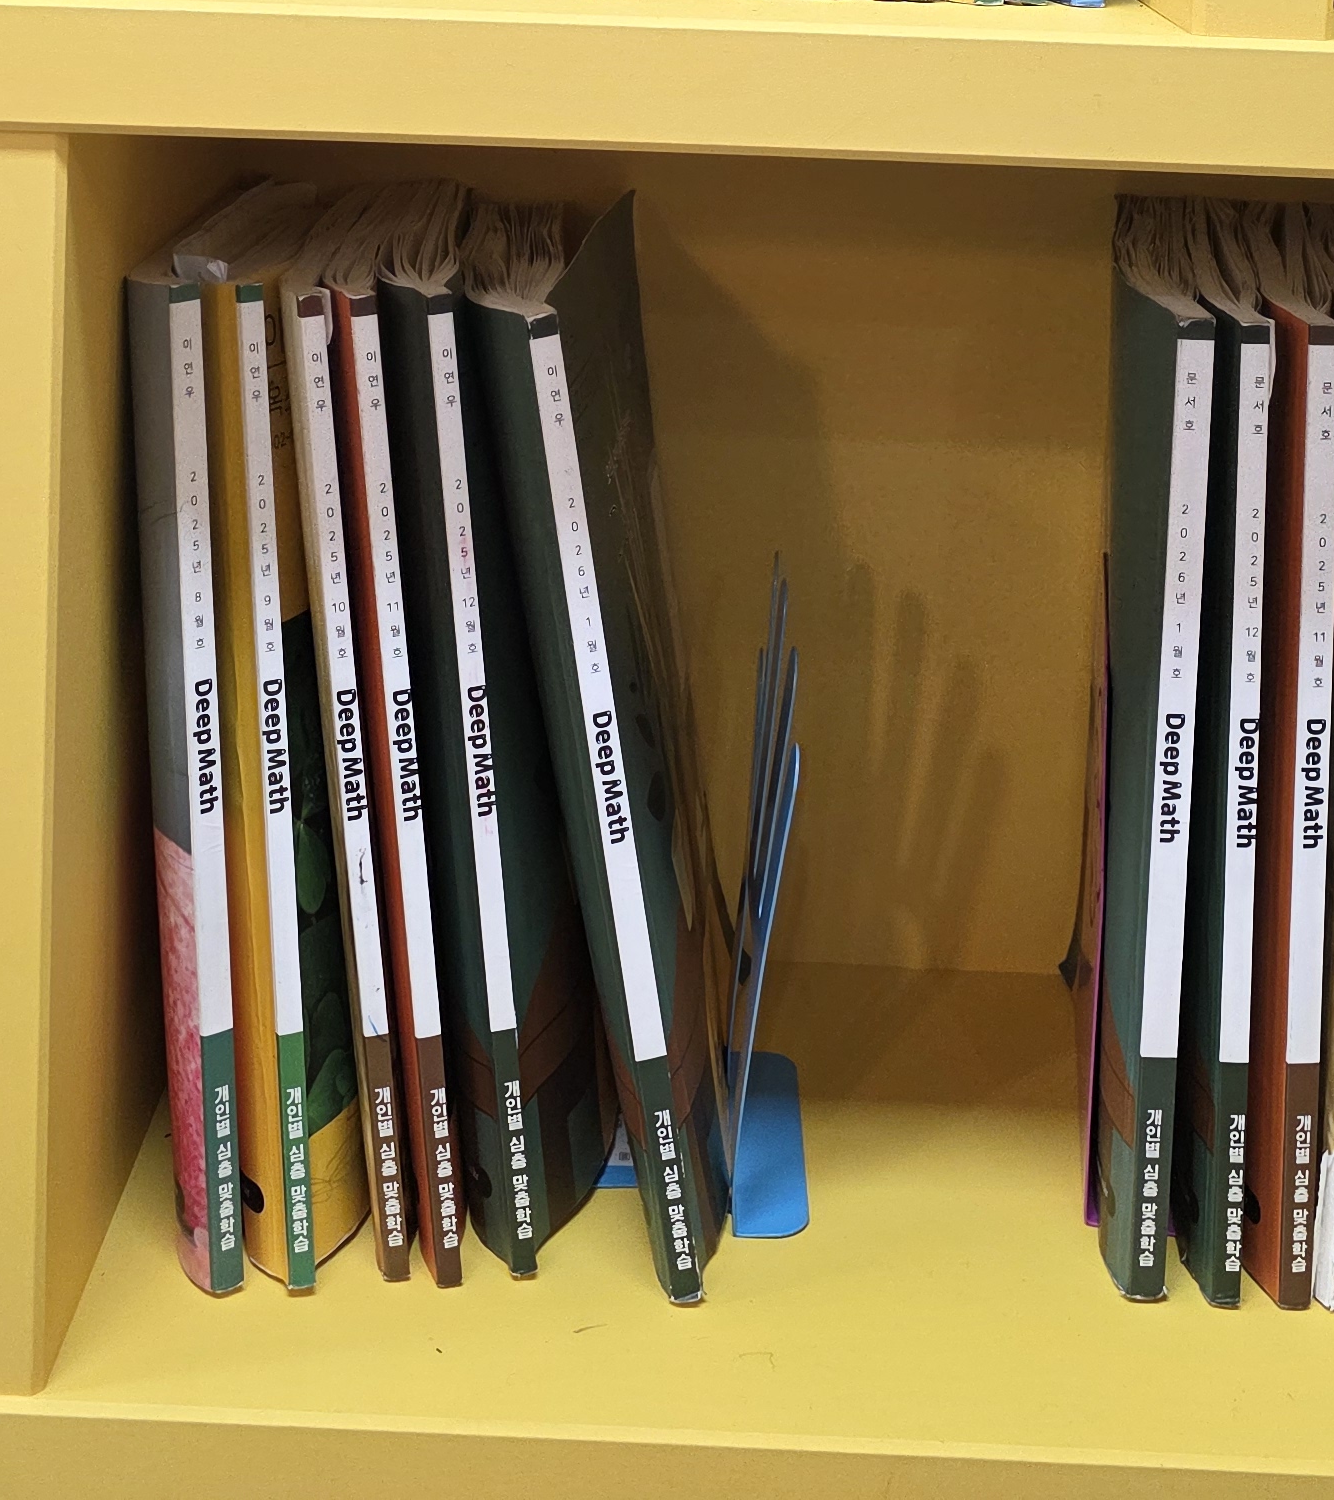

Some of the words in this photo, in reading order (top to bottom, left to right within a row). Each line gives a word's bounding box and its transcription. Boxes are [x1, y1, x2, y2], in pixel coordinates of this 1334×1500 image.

[182, 337, 196, 400] 이연우
[546, 364, 566, 427] 이연우
[1182, 371, 1199, 432] 문서호
[214, 1084, 232, 1140] 개인별
[653, 1108, 678, 1162] 개인별
[1144, 1108, 1164, 1160] 개인별
[216, 1141, 234, 1180] 심층
[662, 1164, 683, 1201] 심층
[1142, 1163, 1160, 1199] 심층
[218, 1181, 237, 1253] 맞춤학습
[667, 1203, 694, 1272] 맞춤학습
[1138, 1202, 1159, 1269] 맞춤학습
